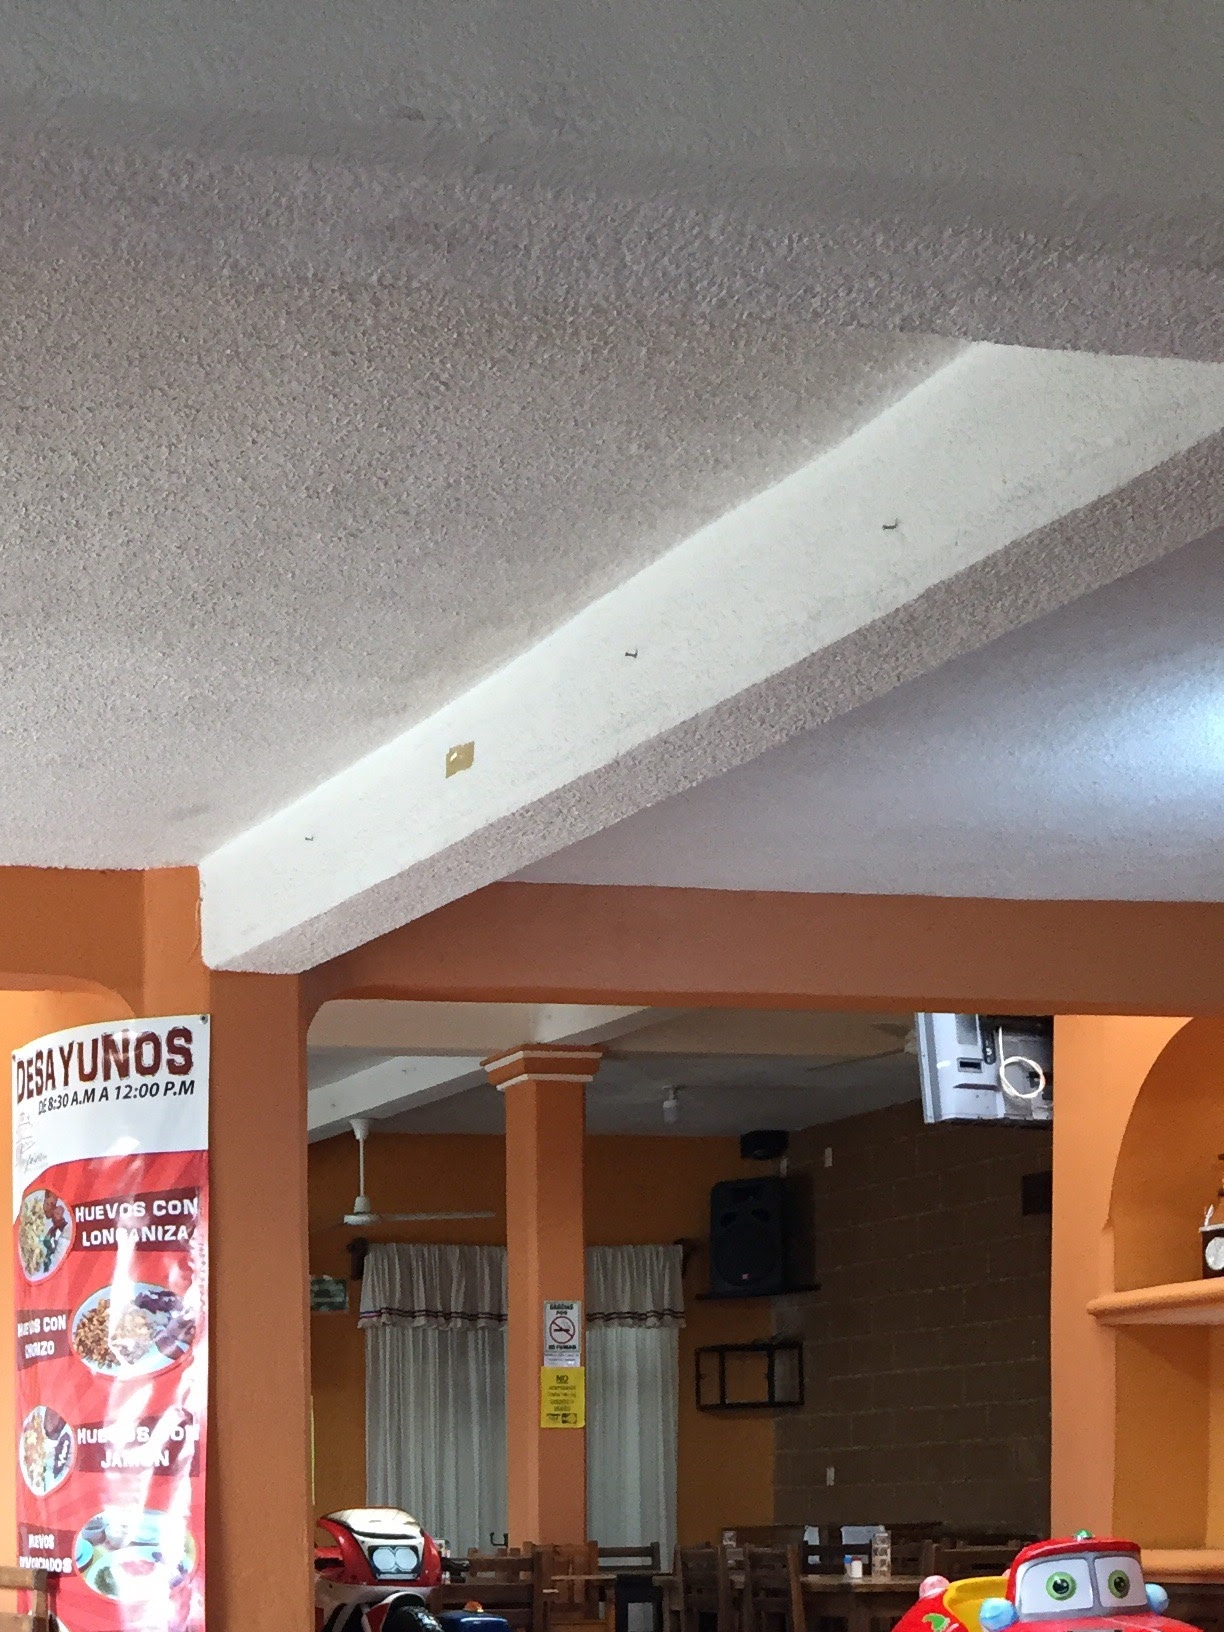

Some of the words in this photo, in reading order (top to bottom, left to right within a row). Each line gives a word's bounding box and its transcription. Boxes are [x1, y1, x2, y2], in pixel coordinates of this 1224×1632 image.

[16, 1025, 193, 1104] DESAYUNOS
[48, 1093, 69, 1112] 8:30
[71, 1090, 96, 1107] A.M
[98, 1087, 109, 1103] A
[115, 1081, 160, 1101] 12:00
[163, 1079, 196, 1097] P.M
[75, 1201, 146, 1223] HUEVOS
[153, 1197, 198, 1217] CON
[43, 1313, 66, 1333] CON
[77, 1426, 150, 1445] HUES
[100, 1448, 170, 1469] JAMN
